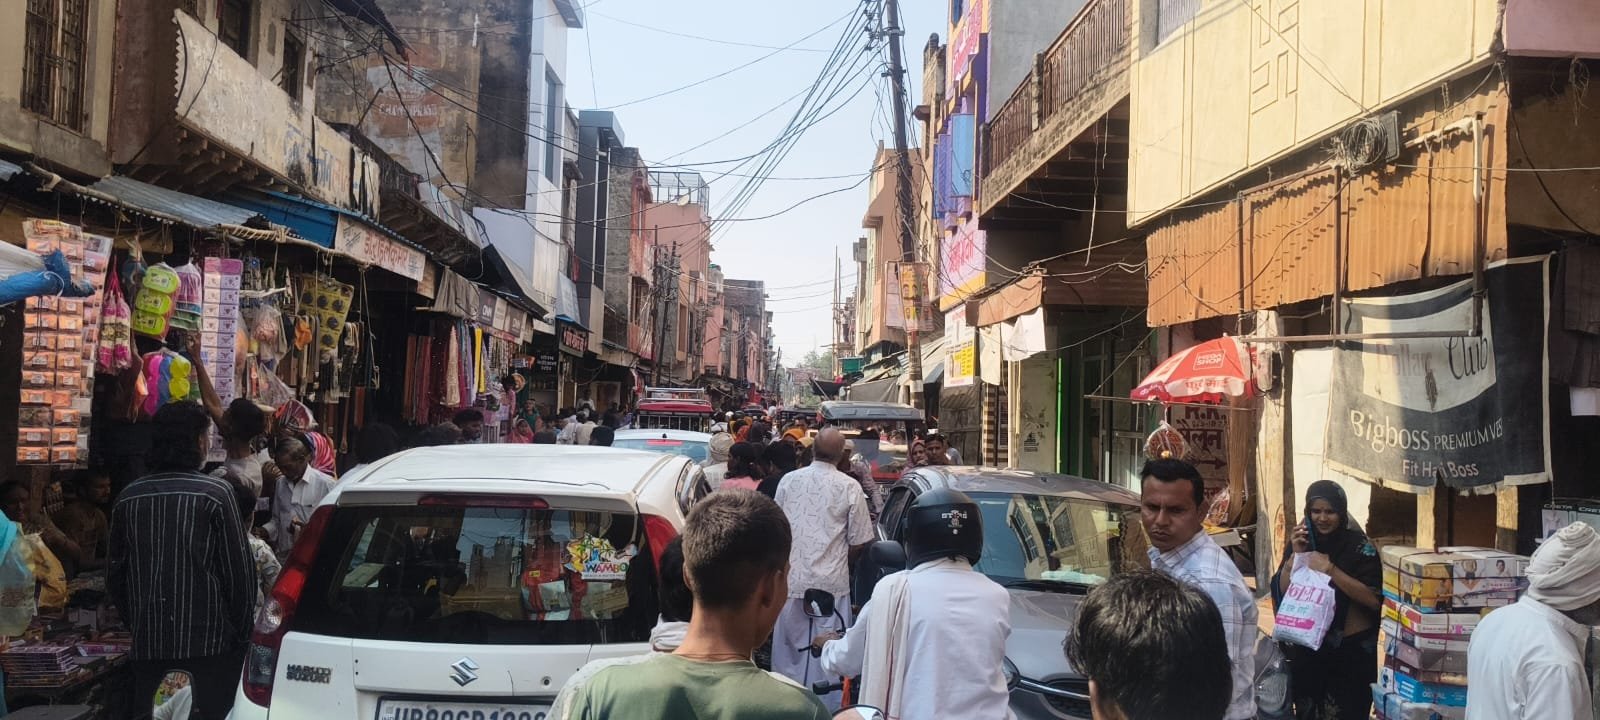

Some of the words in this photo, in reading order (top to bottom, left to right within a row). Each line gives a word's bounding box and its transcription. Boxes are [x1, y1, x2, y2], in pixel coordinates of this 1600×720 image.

[1196, 358, 1222, 366] SHOP
[1443, 336, 1488, 380] Club
[1350, 410, 1430, 453] Bigboss
[1433, 428, 1489, 450] PREMIUM
[1402, 459, 1418, 476] Fit
[1447, 461, 1479, 478] Boss
[286, 671, 331, 684] SUZUKI
[287, 664, 332, 675] MARUTI
